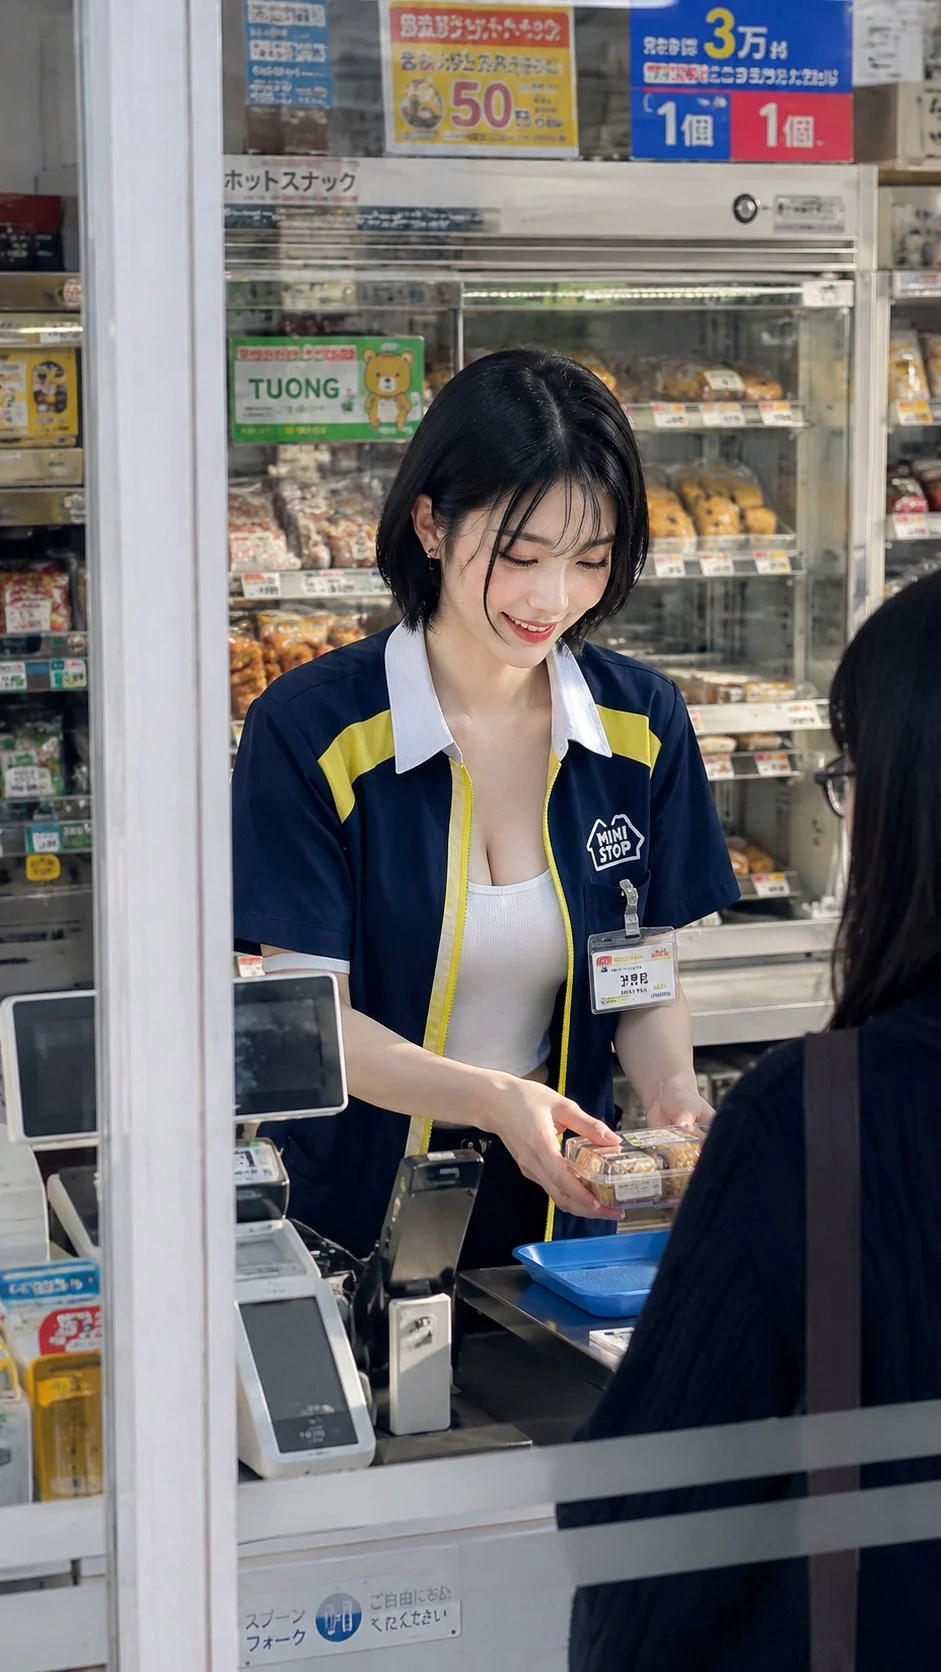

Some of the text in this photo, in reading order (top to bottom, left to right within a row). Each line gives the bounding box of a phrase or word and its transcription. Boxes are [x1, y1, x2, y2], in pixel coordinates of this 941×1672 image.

[224, 169, 356, 192] ホットスナック
[248, 378, 340, 400] TUONG
[596, 825, 628, 847] MINI
[599, 840, 632, 863] STOP
[246, 1629, 306, 1652] フォーク
